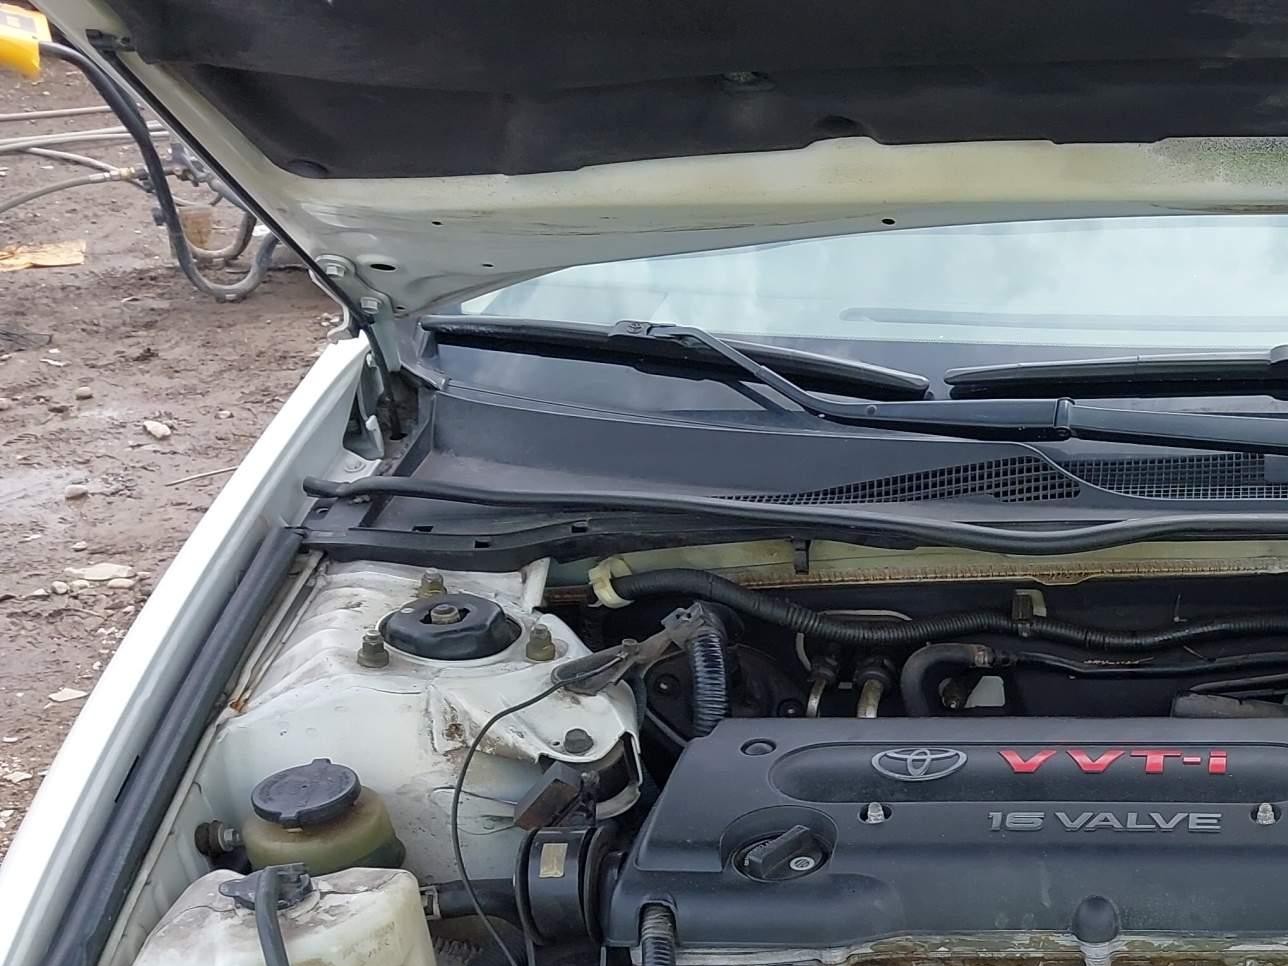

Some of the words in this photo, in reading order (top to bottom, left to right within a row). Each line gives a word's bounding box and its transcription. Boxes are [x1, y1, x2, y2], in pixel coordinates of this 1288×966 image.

[997, 750, 1228, 774] VVT-i
[988, 811, 1046, 832] 16
[1055, 811, 1223, 834] VALVE
